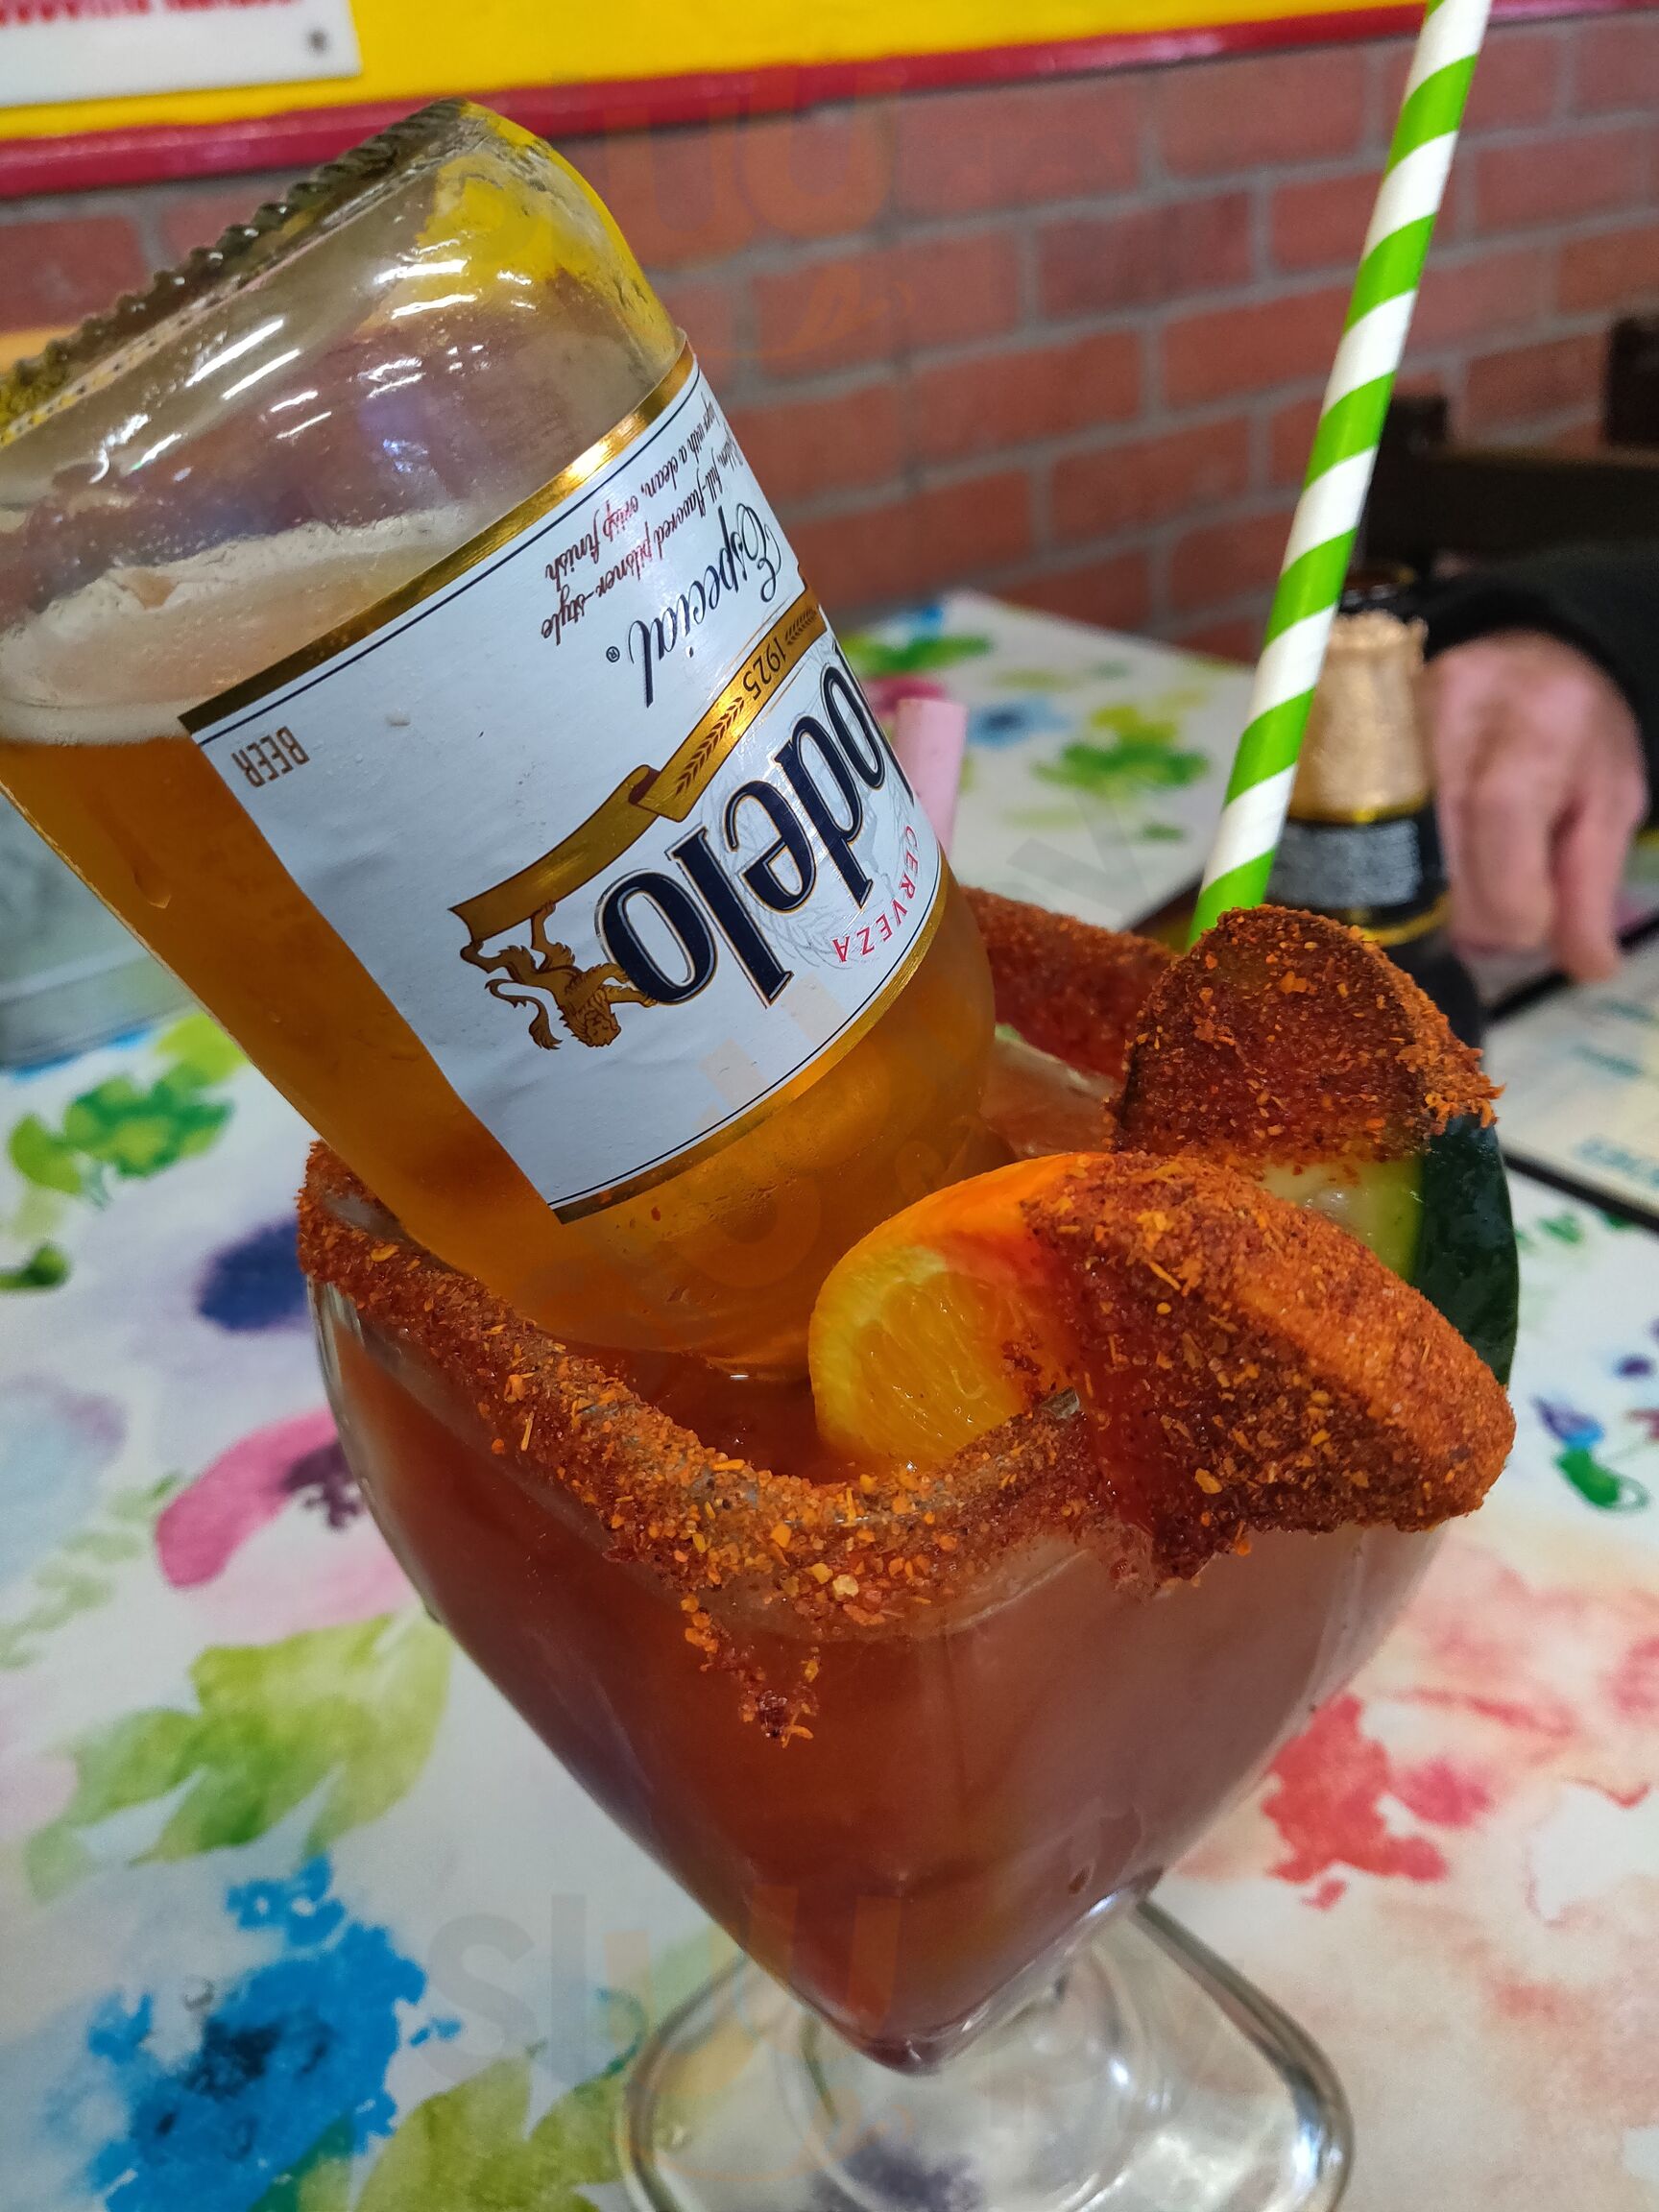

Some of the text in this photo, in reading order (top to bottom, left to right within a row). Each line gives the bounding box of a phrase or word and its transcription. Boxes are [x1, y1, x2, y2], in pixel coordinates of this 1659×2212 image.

[641, 456, 679, 497] clean,
[679, 443, 687, 464] a
[686, 423, 705, 464] with
[603, 496, 638, 541] crisp
[654, 447, 723, 561] full-flavored
[541, 521, 653, 645] pilsner-style
[545, 510, 599, 591] finish
[628, 503, 781, 708] Especial
[743, 637, 787, 701] 1925
[230, 726, 310, 787] BEER
[594, 638, 914, 1009] odelo
[832, 826, 919, 963] CERVEZA
